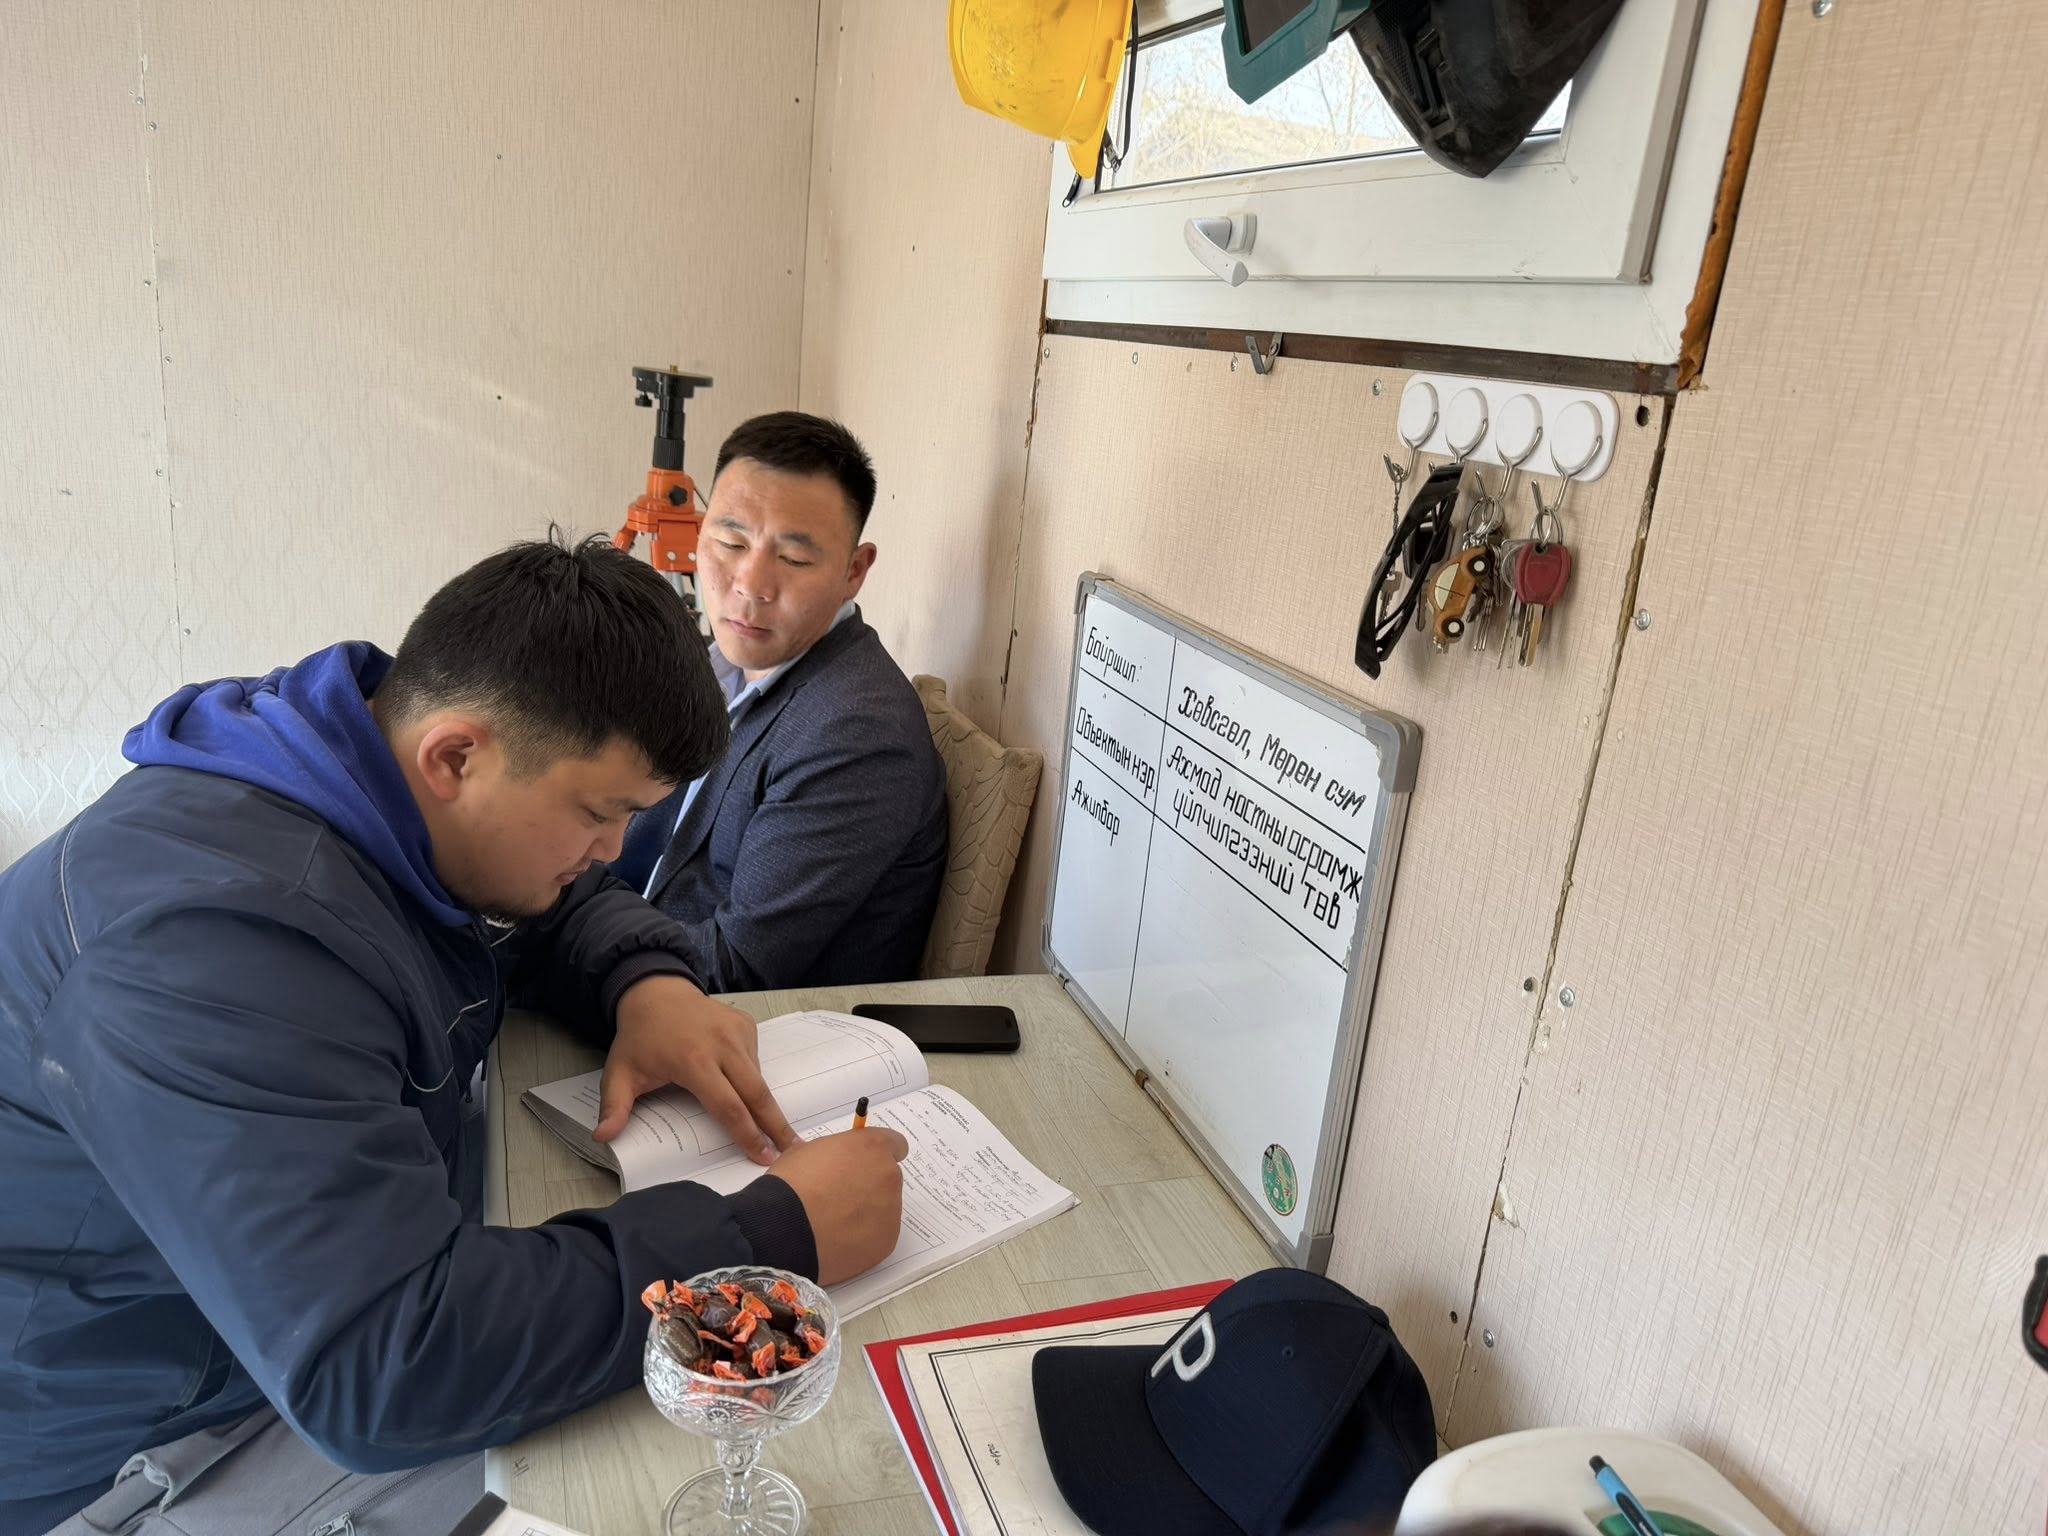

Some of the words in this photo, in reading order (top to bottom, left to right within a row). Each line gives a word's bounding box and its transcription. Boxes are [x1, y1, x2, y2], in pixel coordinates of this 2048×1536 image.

[1071, 779, 1121, 847] Ажилбар
[1259, 733, 1322, 793] Мөрөн
[1324, 779, 1367, 818] сум
[1166, 745, 1223, 801] Ахмад
[1223, 786, 1287, 848] настны
[1286, 829, 1363, 903] асрамж
